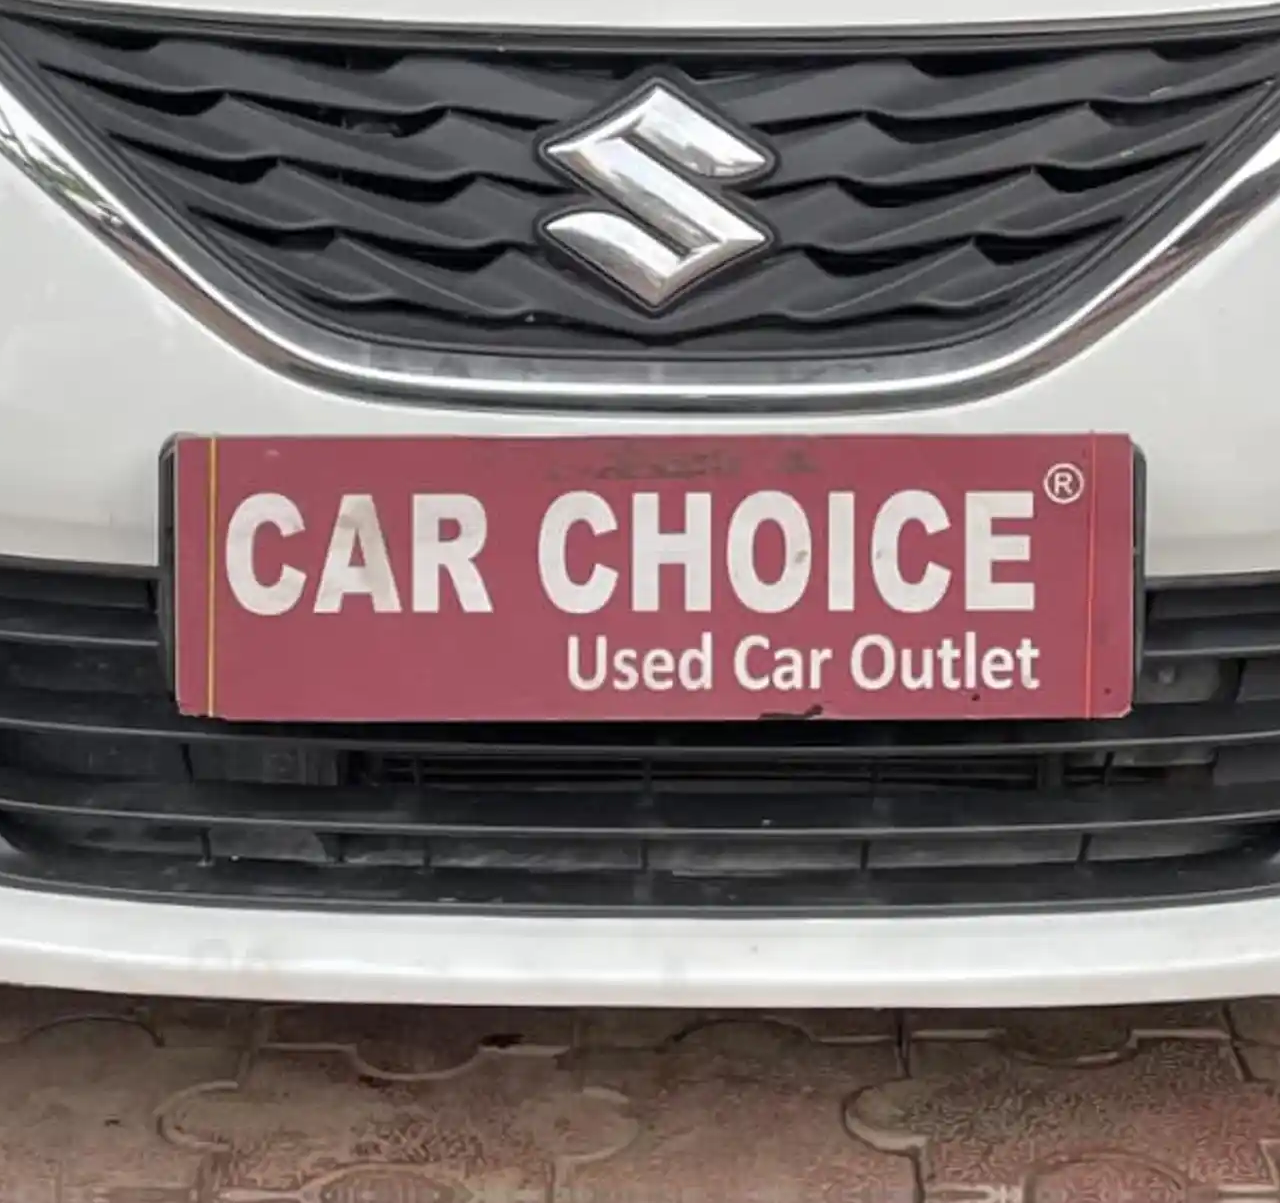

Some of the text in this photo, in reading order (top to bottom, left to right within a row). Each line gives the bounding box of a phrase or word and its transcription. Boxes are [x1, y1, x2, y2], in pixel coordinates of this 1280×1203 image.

[224, 491, 495, 617] CAR
[537, 489, 1037, 615] CHOICE
[566, 631, 1041, 692] Used Car Outlet
